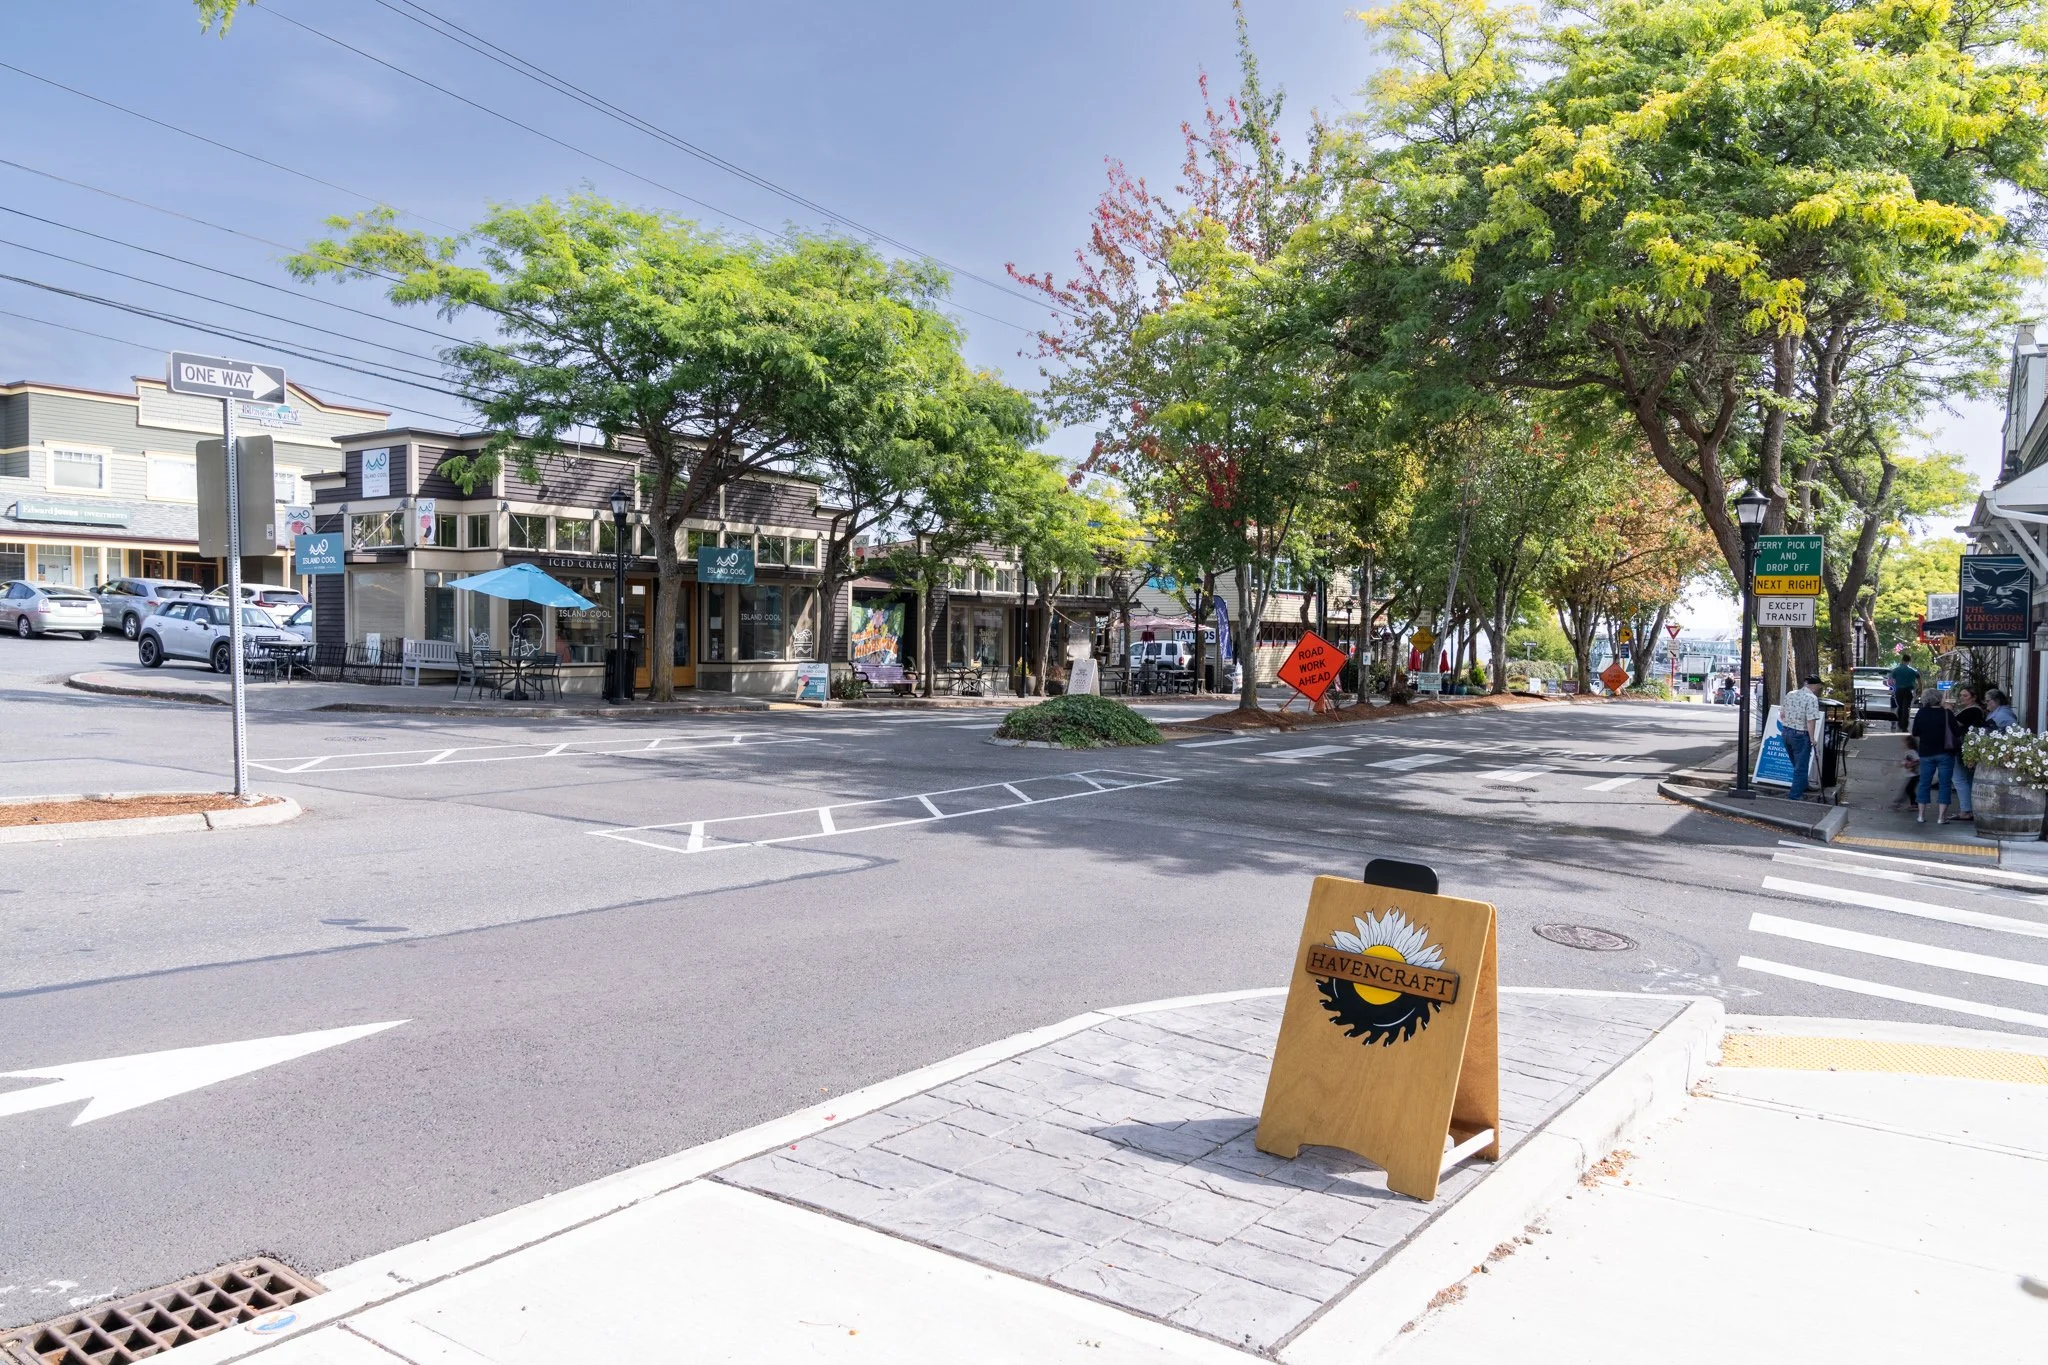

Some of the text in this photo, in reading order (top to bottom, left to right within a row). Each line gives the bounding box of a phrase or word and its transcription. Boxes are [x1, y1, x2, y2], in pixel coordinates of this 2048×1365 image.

[185, 366, 252, 388] ONE WAY
[23, 505, 53, 515] Edward
[54, 507, 79, 517] Jones
[1757, 541, 1821, 549] FERRY PICK UP
[302, 556, 337, 565] ISLAND COOL
[1780, 552, 1797, 560] AND
[548, 559, 629, 570] ICED CREAMEY
[1766, 563, 1810, 572] DROP OFF
[707, 566, 728, 574] ISLAND
[1757, 580, 1818, 590] NEXT RIGHT
[1768, 601, 1805, 610] EXCEPT
[1964, 606, 1985, 614] THE
[559, 610, 612, 618] ISLAND COOL
[741, 613, 782, 621] ISLAND COOL
[1766, 613, 1807, 621] TRANSIT
[1965, 614, 2024, 622] KINGSTON
[1965, 622, 1985, 630] ALE
[1175, 630, 1215, 640] TATTOS
[1298, 646, 1324, 661] ROAD
[1299, 659, 1327, 673] WORK
[1298, 671, 1331, 687] AHEAD
[1311, 952, 1452, 995] HAVENCRAFT
